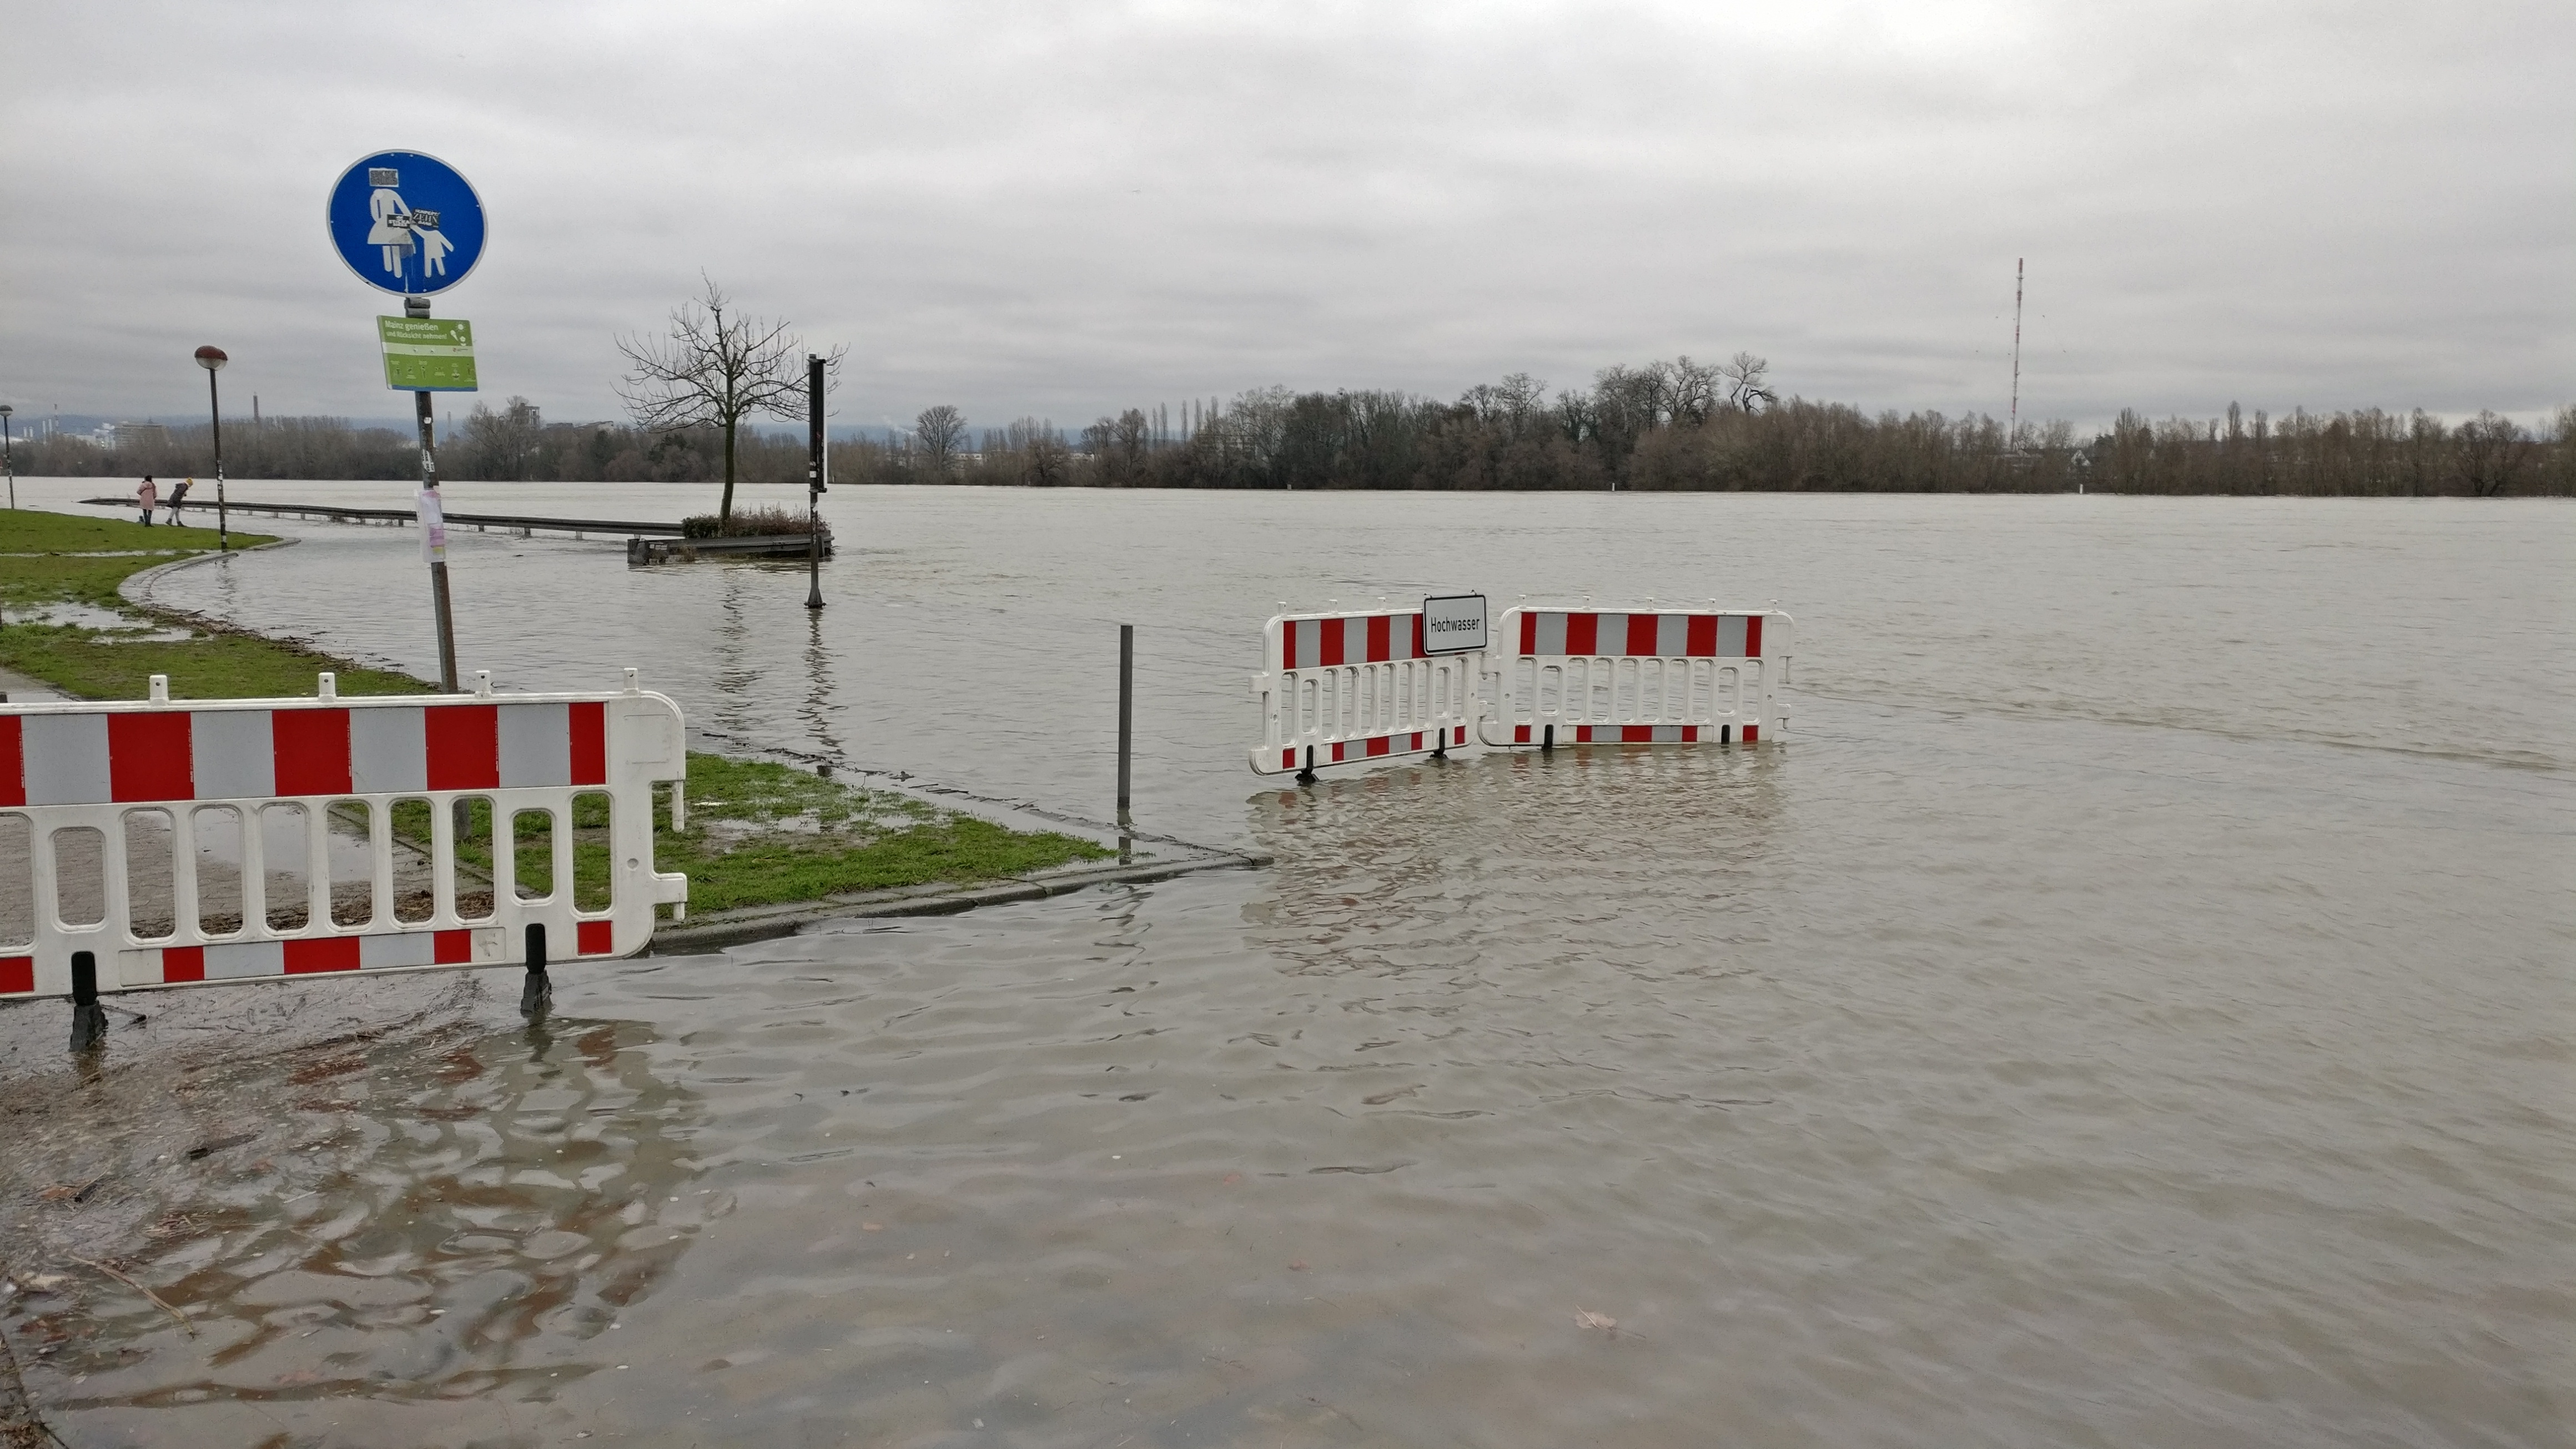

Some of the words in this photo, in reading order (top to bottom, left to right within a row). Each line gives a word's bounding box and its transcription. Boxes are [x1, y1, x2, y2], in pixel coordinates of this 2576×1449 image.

[385, 320, 404, 329] Mainz
[405, 323, 439, 331] genießen
[1431, 616, 1480, 633] Hochwasser
